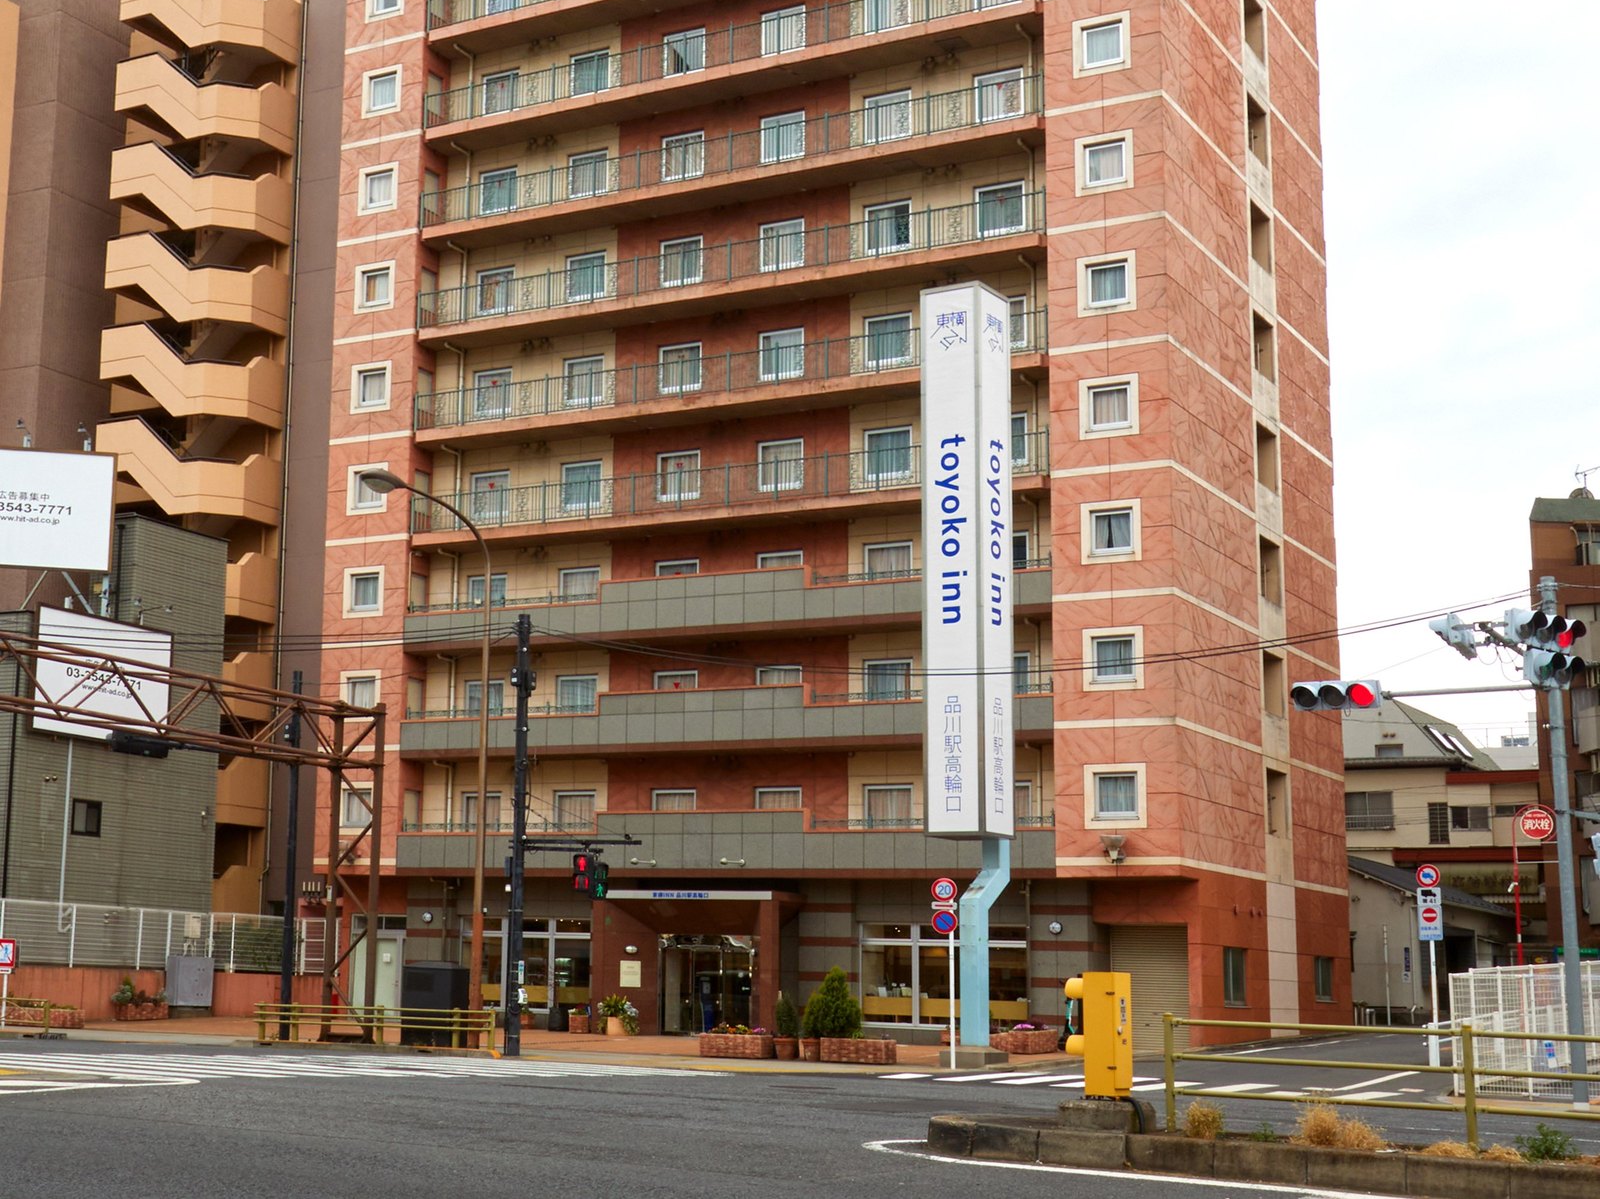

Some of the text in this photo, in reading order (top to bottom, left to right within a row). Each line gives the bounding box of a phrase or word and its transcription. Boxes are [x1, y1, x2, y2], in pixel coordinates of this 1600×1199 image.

[934, 434, 969, 625] toyoko inn
[986, 439, 1006, 627] toyoko inn
[944, 695, 962, 812] 品川駅高輪口
[937, 884, 952, 896] 20
